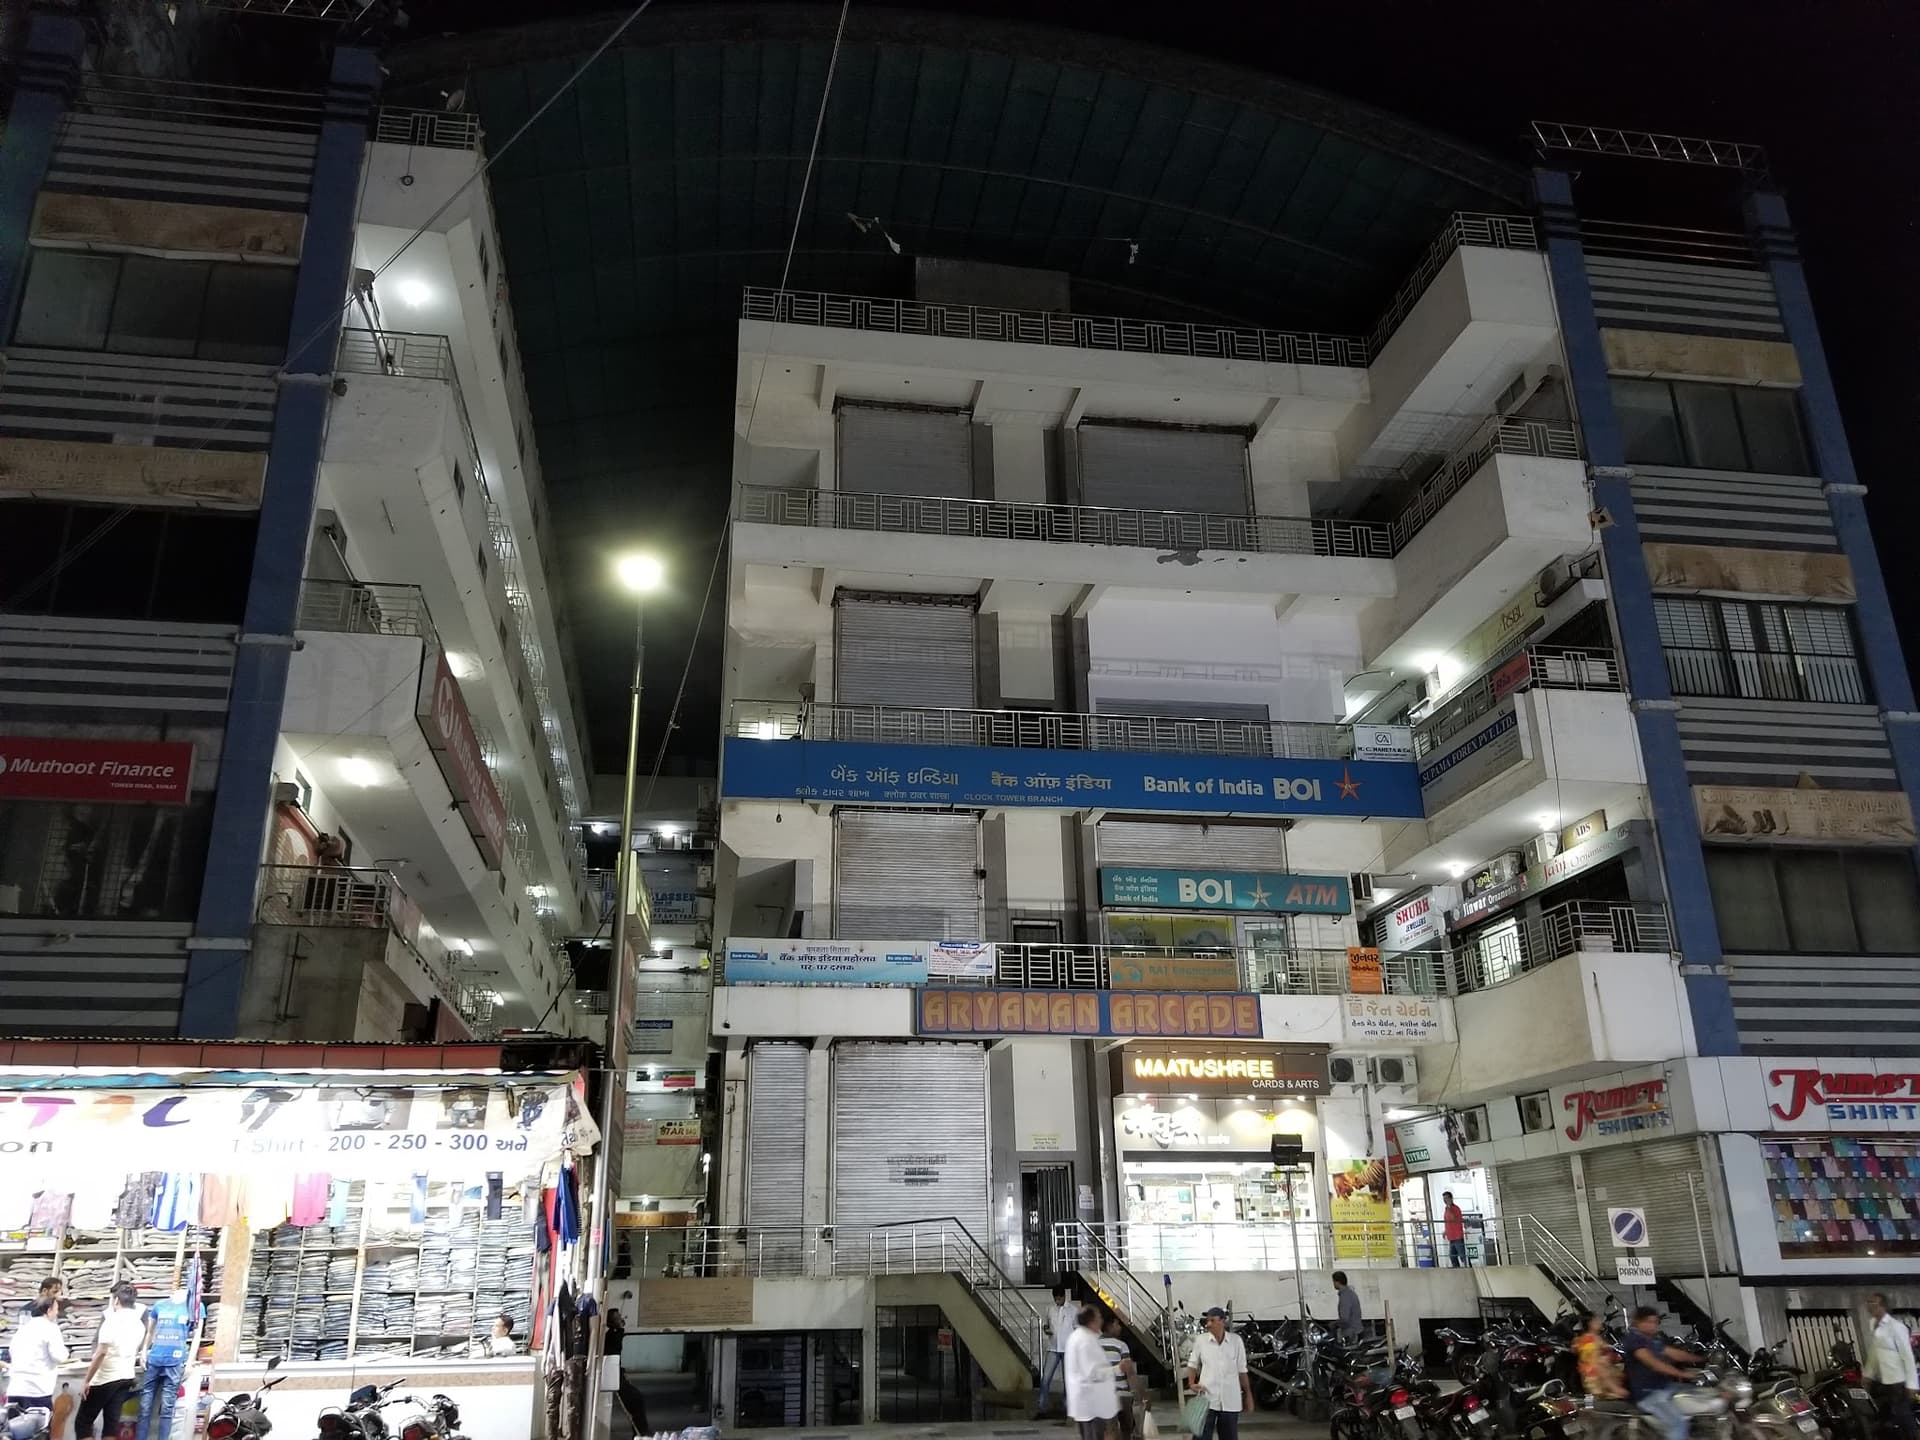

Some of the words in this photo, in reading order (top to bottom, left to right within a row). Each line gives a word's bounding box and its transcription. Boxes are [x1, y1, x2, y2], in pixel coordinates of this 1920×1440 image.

[1502, 605, 1524, 631] RSBL
[10, 758, 96, 775] Muthoot
[100, 761, 174, 777] Finance
[1065, 774, 1112, 791] इंडिया
[1144, 776, 1192, 794] Bank
[1195, 776, 1215, 794] of
[1219, 778, 1264, 796] India
[1273, 778, 1322, 801] BOI
[964, 793, 992, 801] CLOCK
[996, 794, 1026, 802] TOWER
[1027, 795, 1063, 803] BRANCH
[1544, 857, 1566, 884] Jain
[1178, 878, 1233, 904] BOI
[1285, 883, 1338, 906] ATM
[1396, 896, 1430, 926] SHUBH
[1463, 897, 1487, 917] Jinwar
[925, 997, 1098, 1029] ARYAMAN
[1112, 999, 1255, 1031] ARCADE
[1134, 1058, 1275, 1079] MAATUSHREE
[1252, 1079, 1285, 1089] CARDS
[1287, 1080, 1294, 1089] &
[1295, 1080, 1320, 1089] ARTS
[1597, 1111, 1671, 1136] SHIRTS
[328, 1134, 366, 1152] 200
[388, 1134, 427, 1150] 250
[449, 1134, 488, 1151] 300
[495, 1134, 528, 1152] અને
[1619, 1268, 1652, 1276] PARKING
[1628, 1259, 1640, 1267] NO
